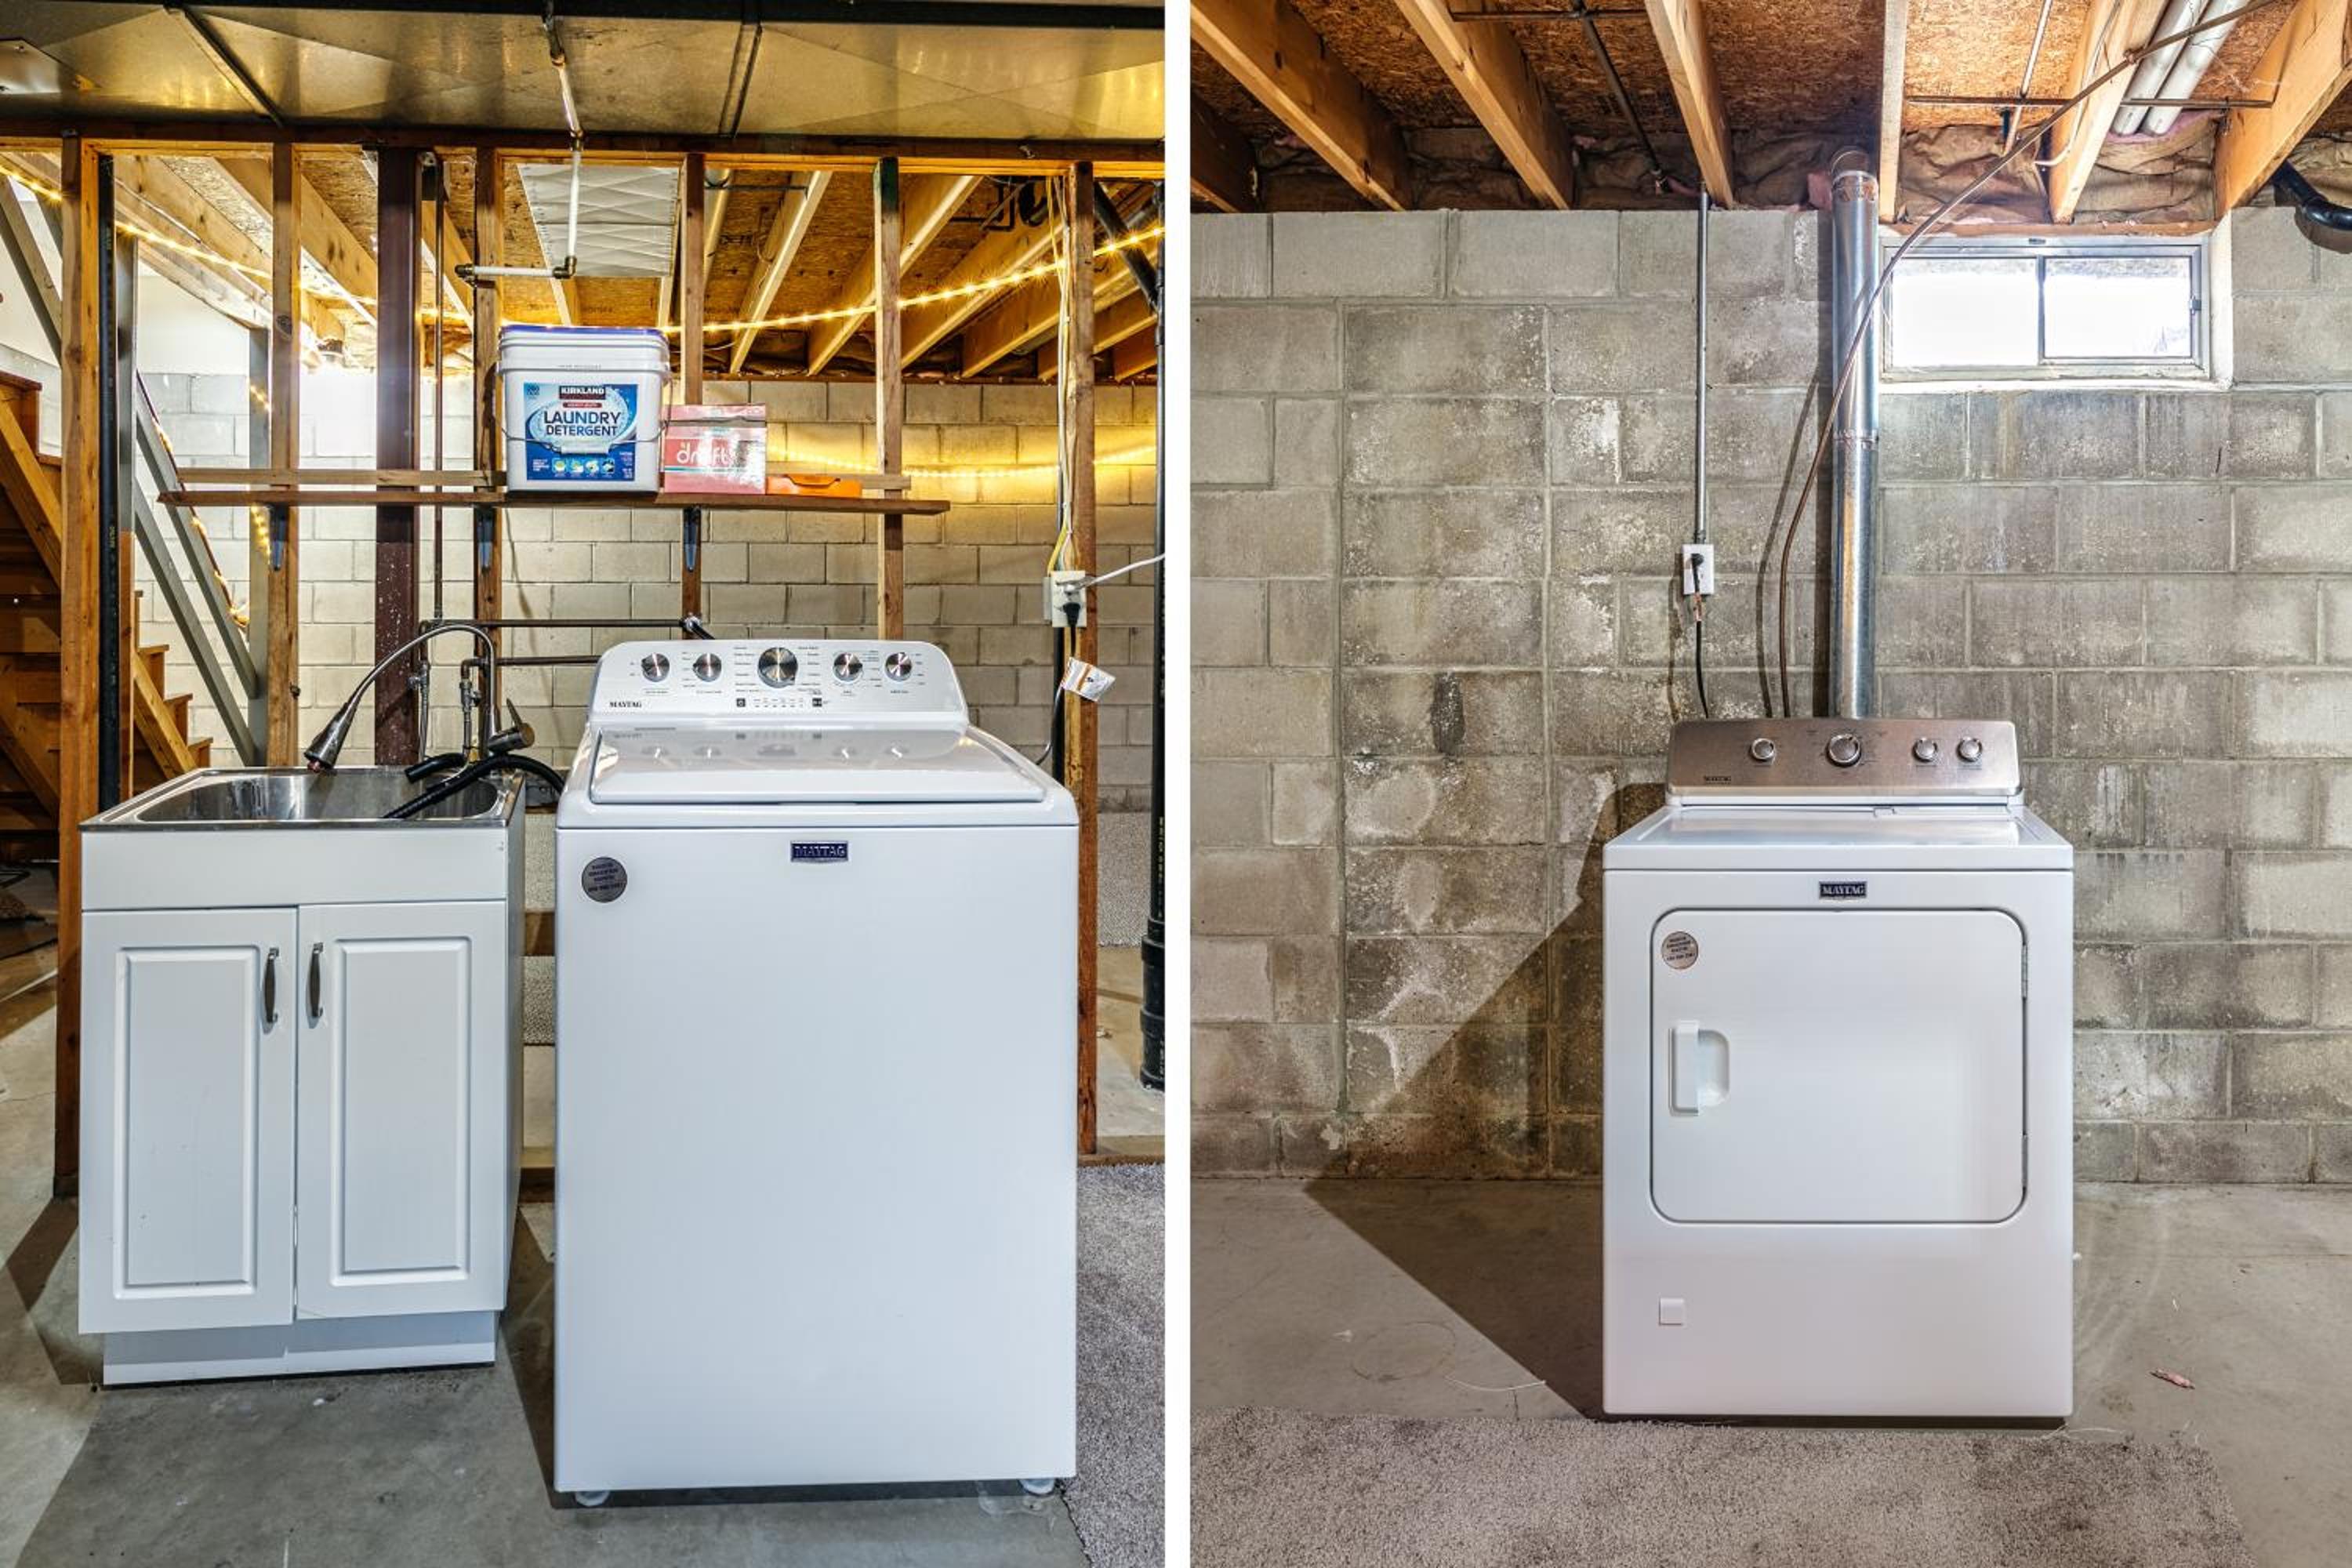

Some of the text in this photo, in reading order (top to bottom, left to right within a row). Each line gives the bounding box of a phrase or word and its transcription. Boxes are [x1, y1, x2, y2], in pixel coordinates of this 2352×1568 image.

[543, 411, 622, 424] LAUNDRY
[546, 426, 619, 437] DETERGENT
[793, 845, 845, 857] MAYTAG
[1821, 884, 1864, 895] MAYTAG
